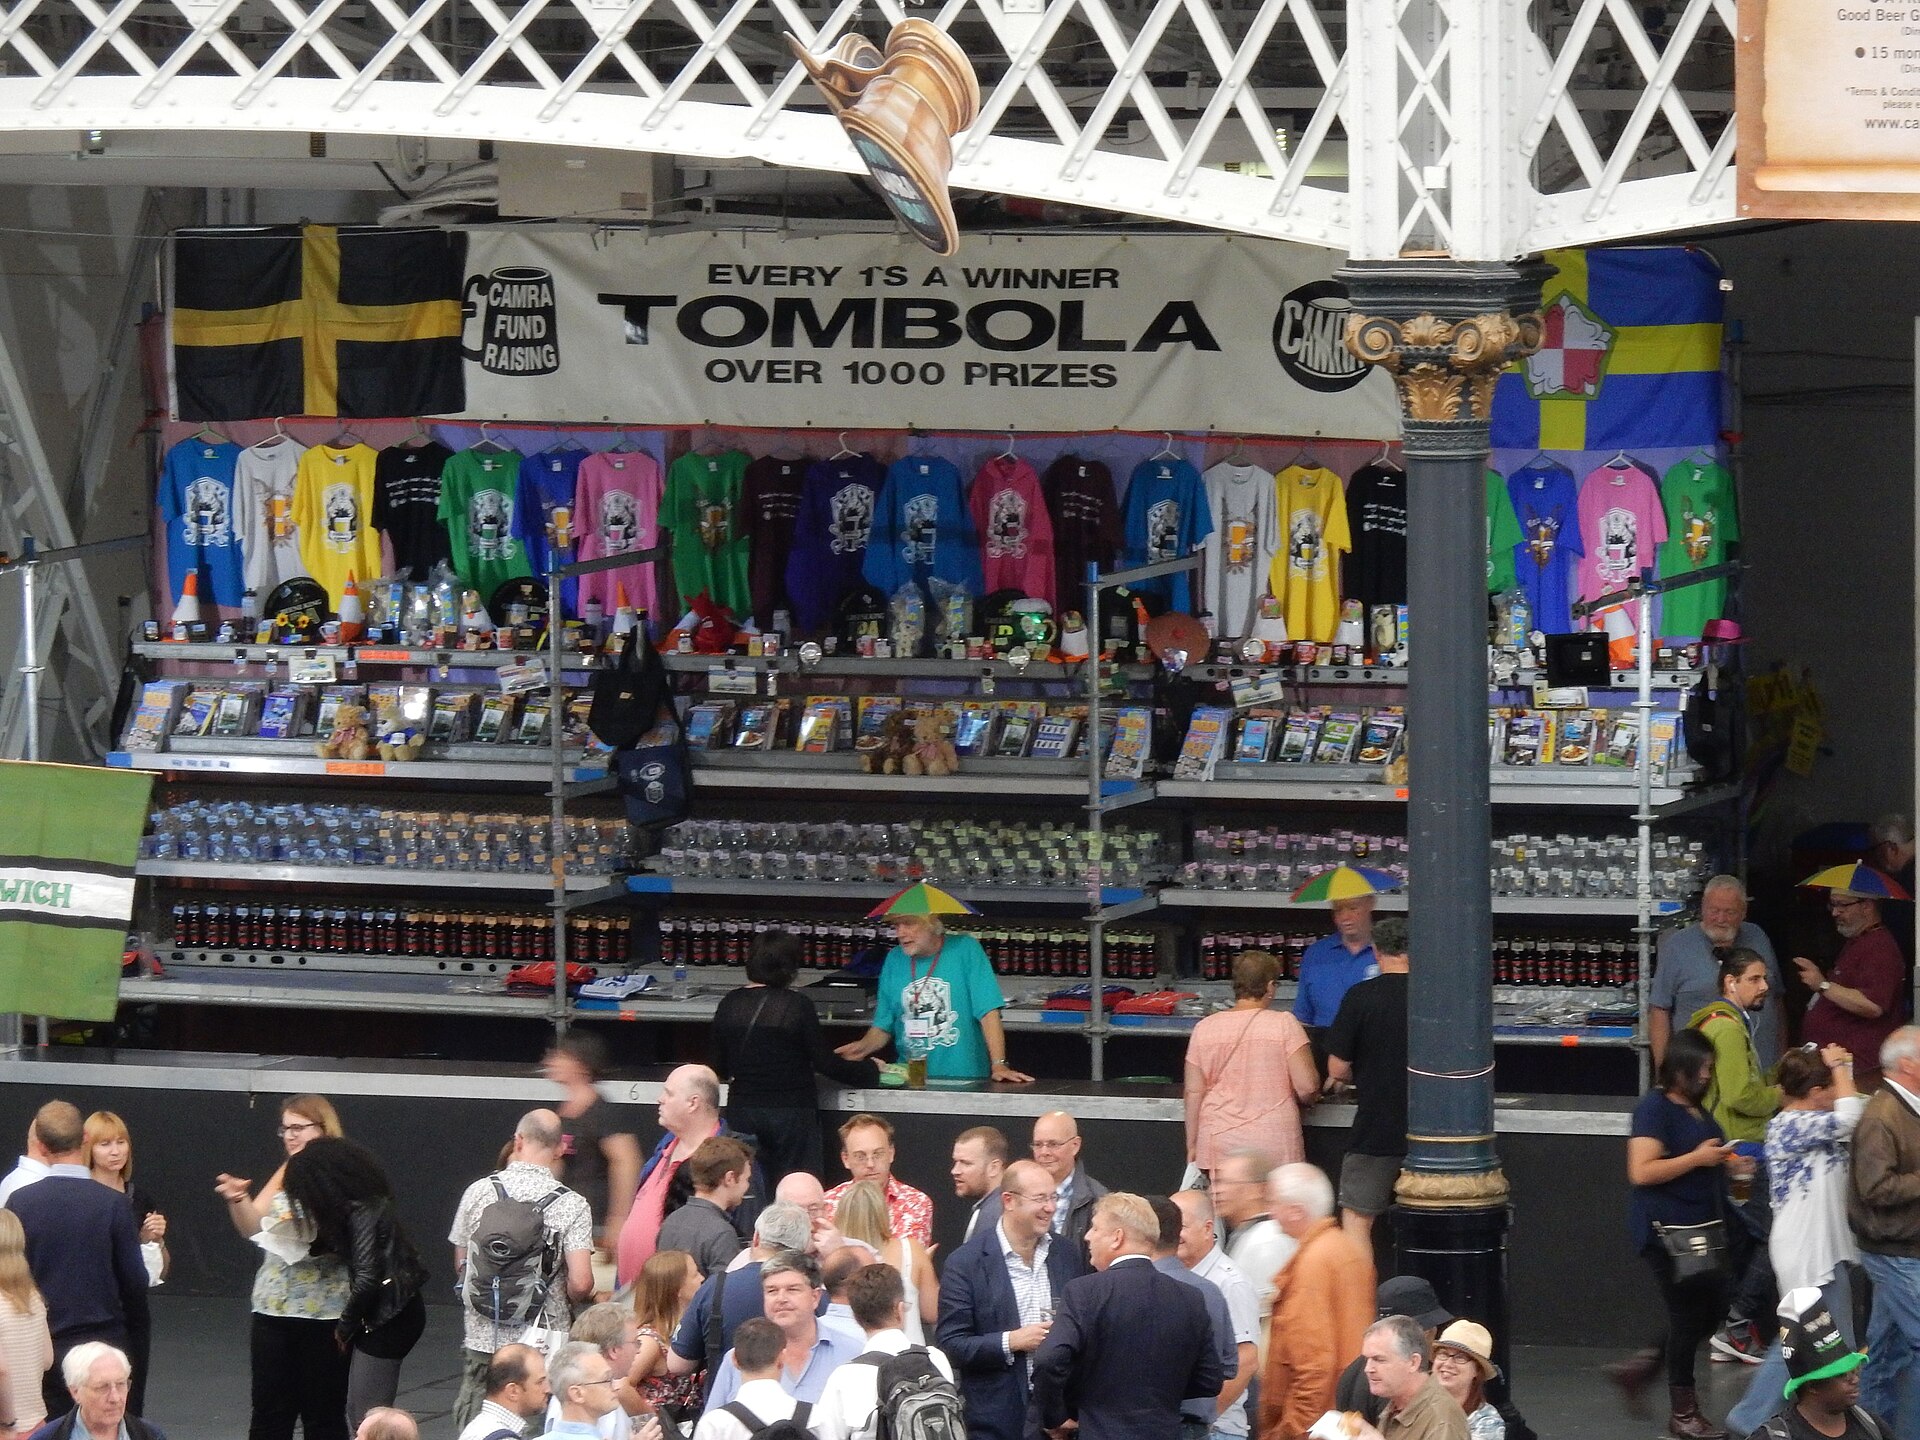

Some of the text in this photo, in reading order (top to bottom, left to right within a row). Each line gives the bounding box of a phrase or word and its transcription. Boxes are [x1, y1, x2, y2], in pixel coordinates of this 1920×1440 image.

[1837, 8, 1870, 21] Good
[1876, 8, 1905, 21] Beer
[1872, 46, 1889, 59] 15
[1881, 87, 1887, 96] &
[1882, 100, 1912, 110] please
[707, 263, 843, 287] EVERY
[921, 266, 949, 287] A
[961, 267, 1120, 290] WINNER
[488, 282, 554, 308] CAMRA
[494, 314, 547, 340] FUND
[597, 292, 1223, 353] TOMBOLA
[484, 342, 558, 371] RAISING
[704, 358, 1118, 389] OVER 1000 PRIZES
[628, 1083, 640, 1100] 6
[847, 1092, 857, 1108] 5
